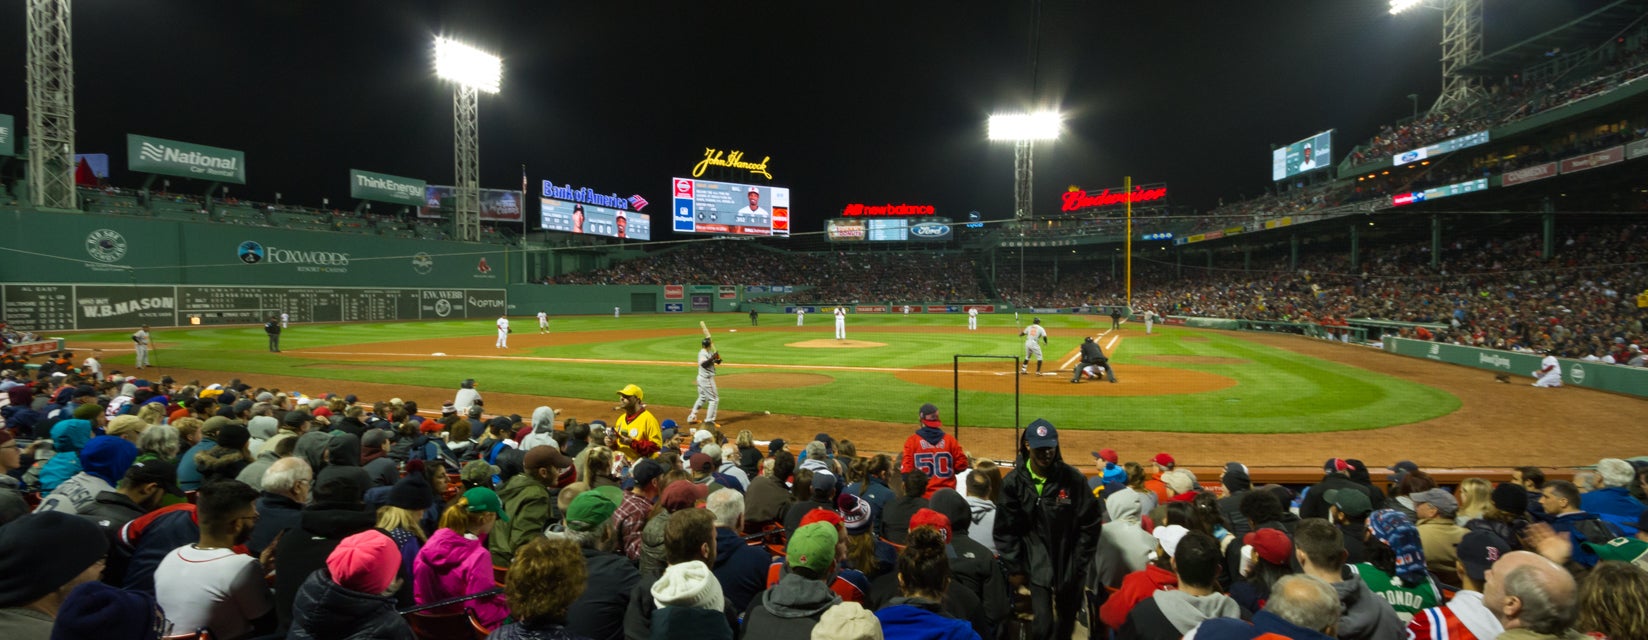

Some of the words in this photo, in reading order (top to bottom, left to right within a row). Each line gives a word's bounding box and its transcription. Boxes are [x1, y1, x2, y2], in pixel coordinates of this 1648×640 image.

[164, 147, 237, 170] National
[190, 165, 205, 173] Car
[692, 147, 724, 178] John
[726, 150, 773, 180] Hancock
[356, 174, 422, 197] ThinkEnergy
[542, 179, 574, 201] Bank
[574, 186, 587, 202] of
[587, 188, 628, 210] America
[864, 205, 887, 216] new
[888, 203, 935, 216] balance
[1061, 185, 1167, 212] Budweiser
[266, 246, 351, 266] FOXWOODS
[476, 299, 505, 308] OPTUM
[913, 451, 954, 479] 50
